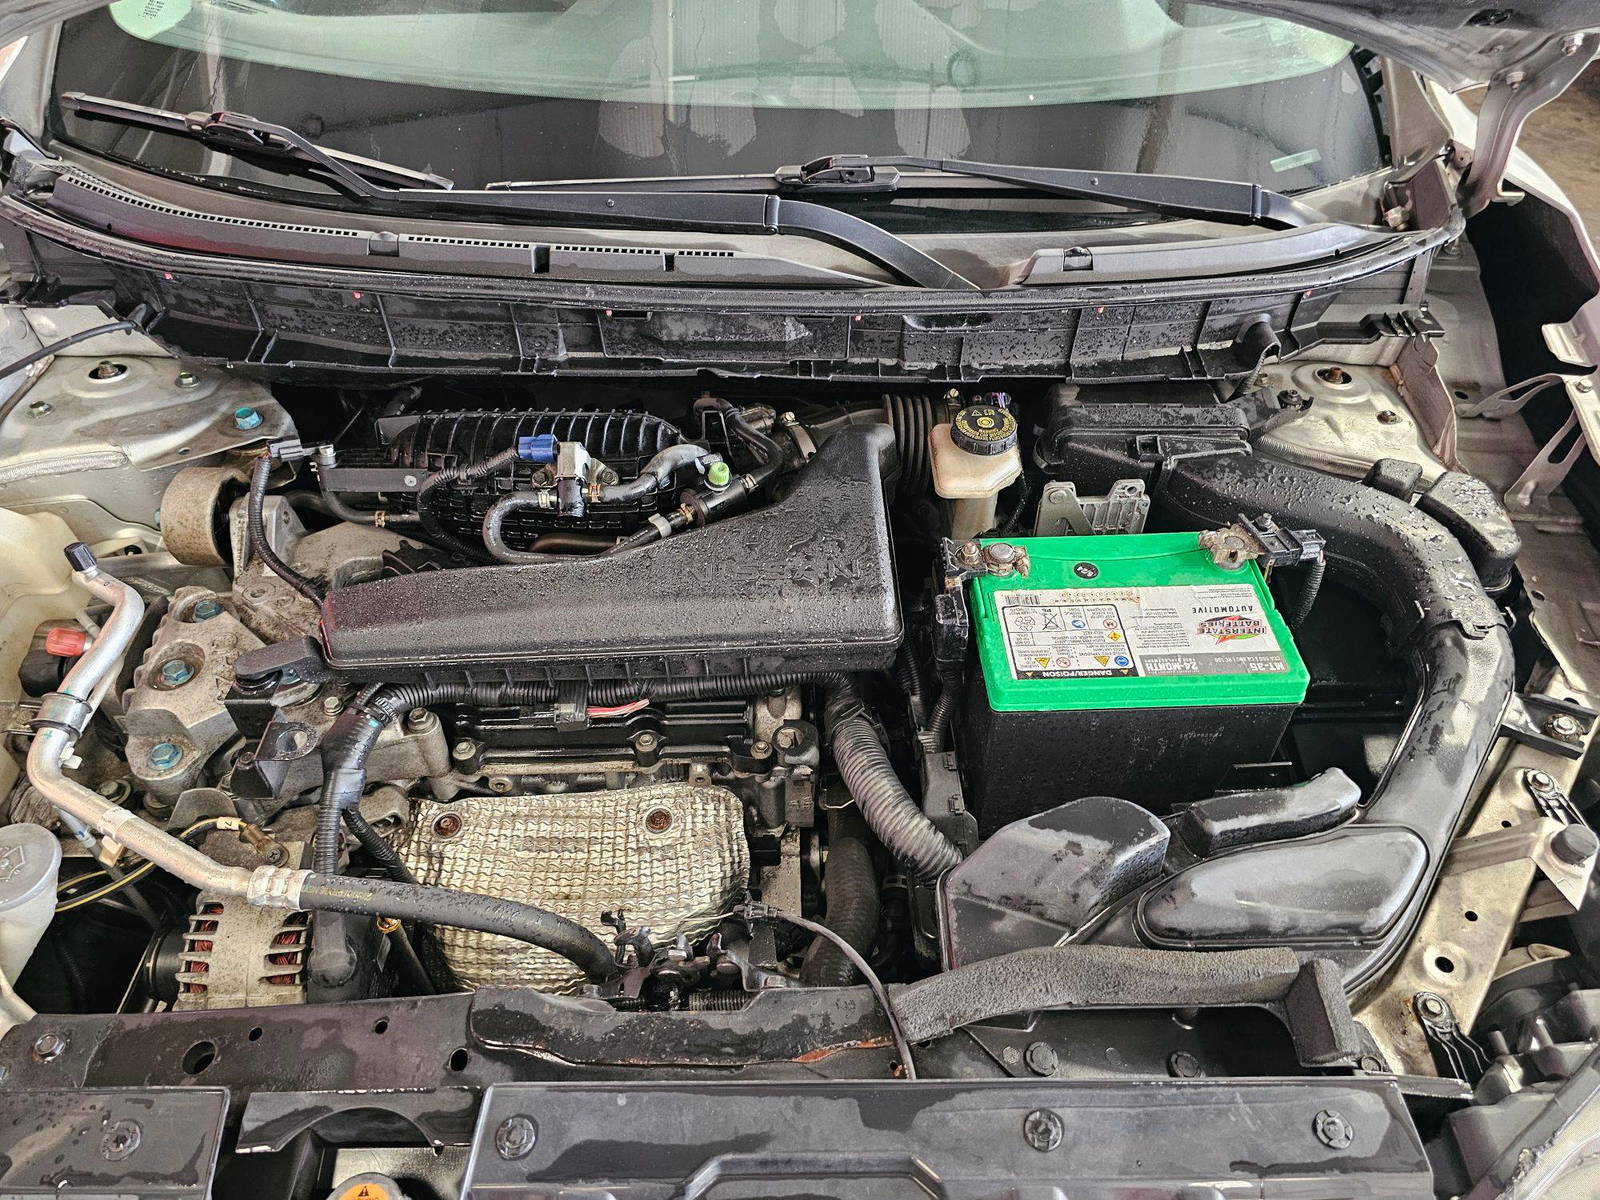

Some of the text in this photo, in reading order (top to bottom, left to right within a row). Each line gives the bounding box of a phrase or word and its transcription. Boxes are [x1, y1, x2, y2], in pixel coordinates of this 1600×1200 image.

[1191, 605, 1253, 614] AUTOMOTIVE
[1198, 627, 1265, 635] INTERSTATE
[1145, 662, 1198, 671] 24-MONTH
[1249, 662, 1285, 671] MT-35
[1042, 669, 1113, 677] DANGER/POISON
